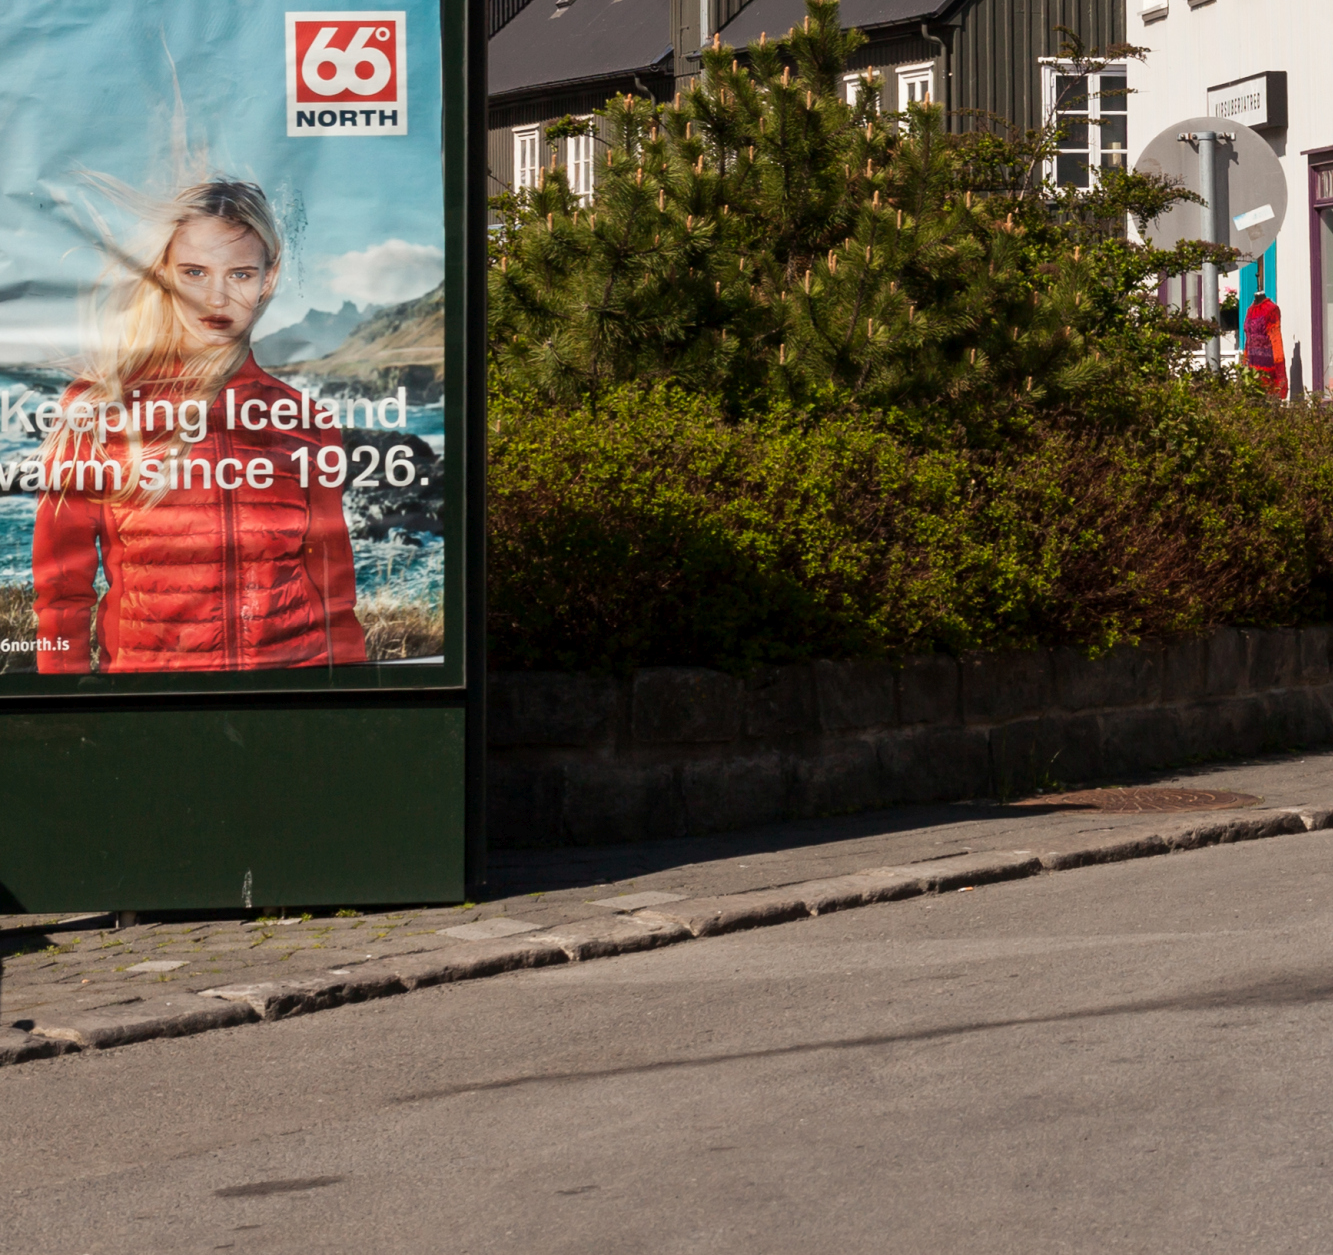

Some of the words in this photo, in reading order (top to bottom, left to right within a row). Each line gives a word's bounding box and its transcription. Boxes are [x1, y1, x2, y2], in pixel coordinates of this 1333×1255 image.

[296, 109, 398, 127] NORTH
[1, 389, 208, 443] Keeping
[225, 386, 408, 432] Iceland
[138, 449, 274, 491] since
[290, 445, 430, 488] 1926.
